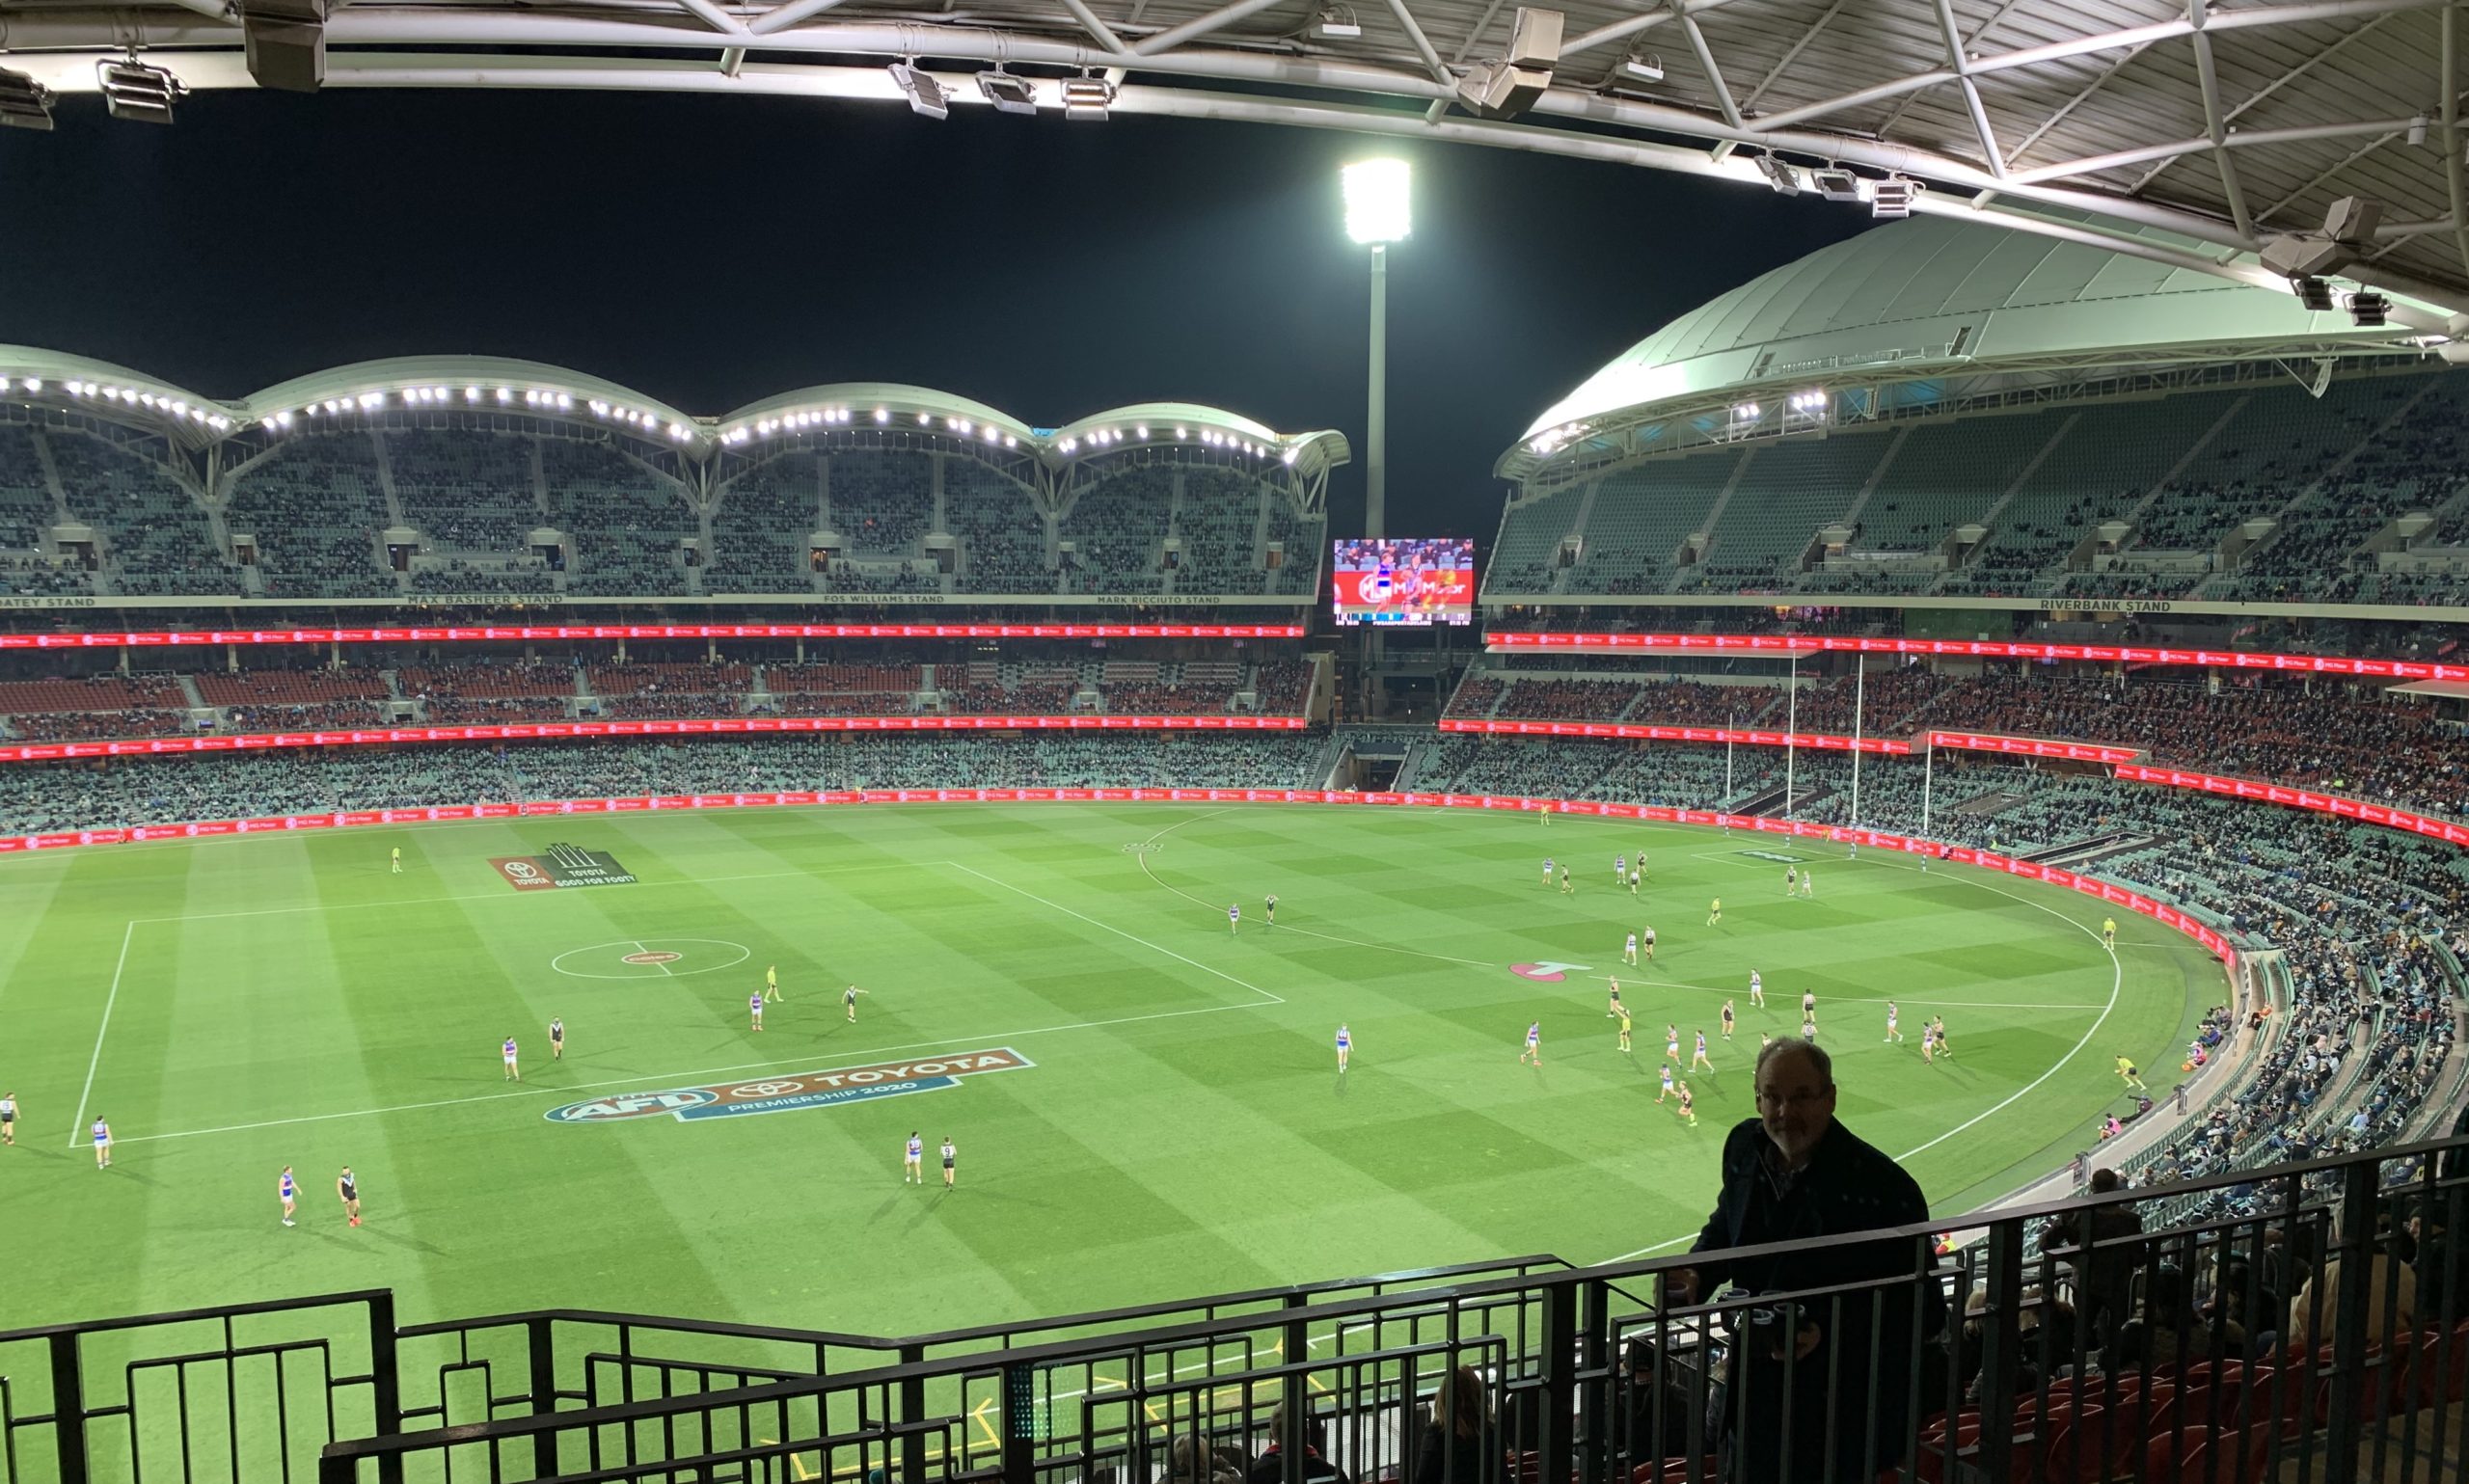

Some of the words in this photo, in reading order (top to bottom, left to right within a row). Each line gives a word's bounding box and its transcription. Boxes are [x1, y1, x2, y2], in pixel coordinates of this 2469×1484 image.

[408, 595, 438, 604] MAX
[445, 595, 510, 604] BASHEER
[2041, 599, 2121, 610] RIVERBANK
[2126, 601, 2170, 612] STAND
[569, 868, 607, 877] TOYOTA
[514, 878, 550, 886] TOYOTA
[606, 875, 636, 884] FOOTY
[814, 1054, 1011, 1087] TOYOTA
[728, 1090, 857, 1113] PREMIERSHIP
[860, 1081, 919, 1096] 2020
[564, 1093, 706, 1120] AFL
